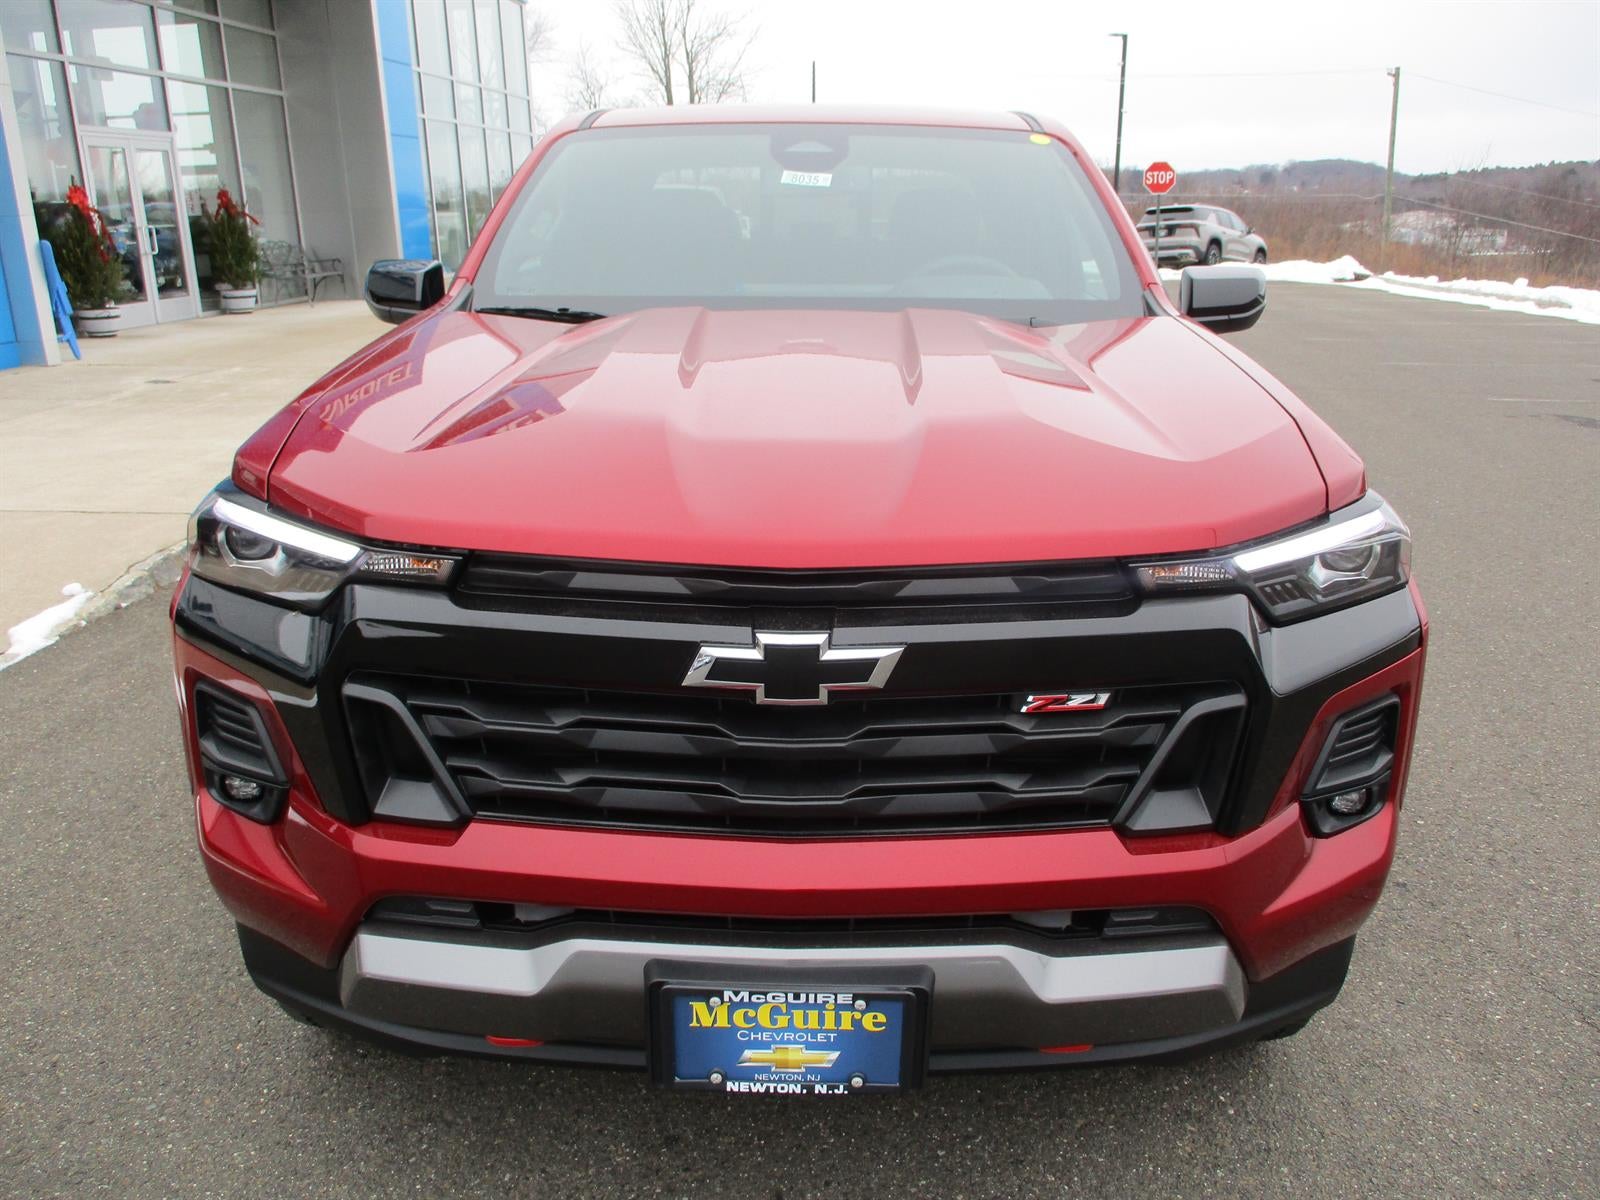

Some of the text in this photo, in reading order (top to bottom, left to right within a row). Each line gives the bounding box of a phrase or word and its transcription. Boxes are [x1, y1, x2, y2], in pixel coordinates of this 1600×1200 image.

[791, 174, 820, 185] 8035
[1145, 171, 1174, 185] STOP
[1020, 693, 1111, 713] Z71
[723, 990, 853, 1004] McGUIRE
[689, 1001, 887, 1032] McGuire
[736, 1030, 838, 1042] CHEVROLET
[754, 1073, 822, 1082] NEWTON, NJ
[726, 1081, 848, 1095] NEWTON, N.J.
